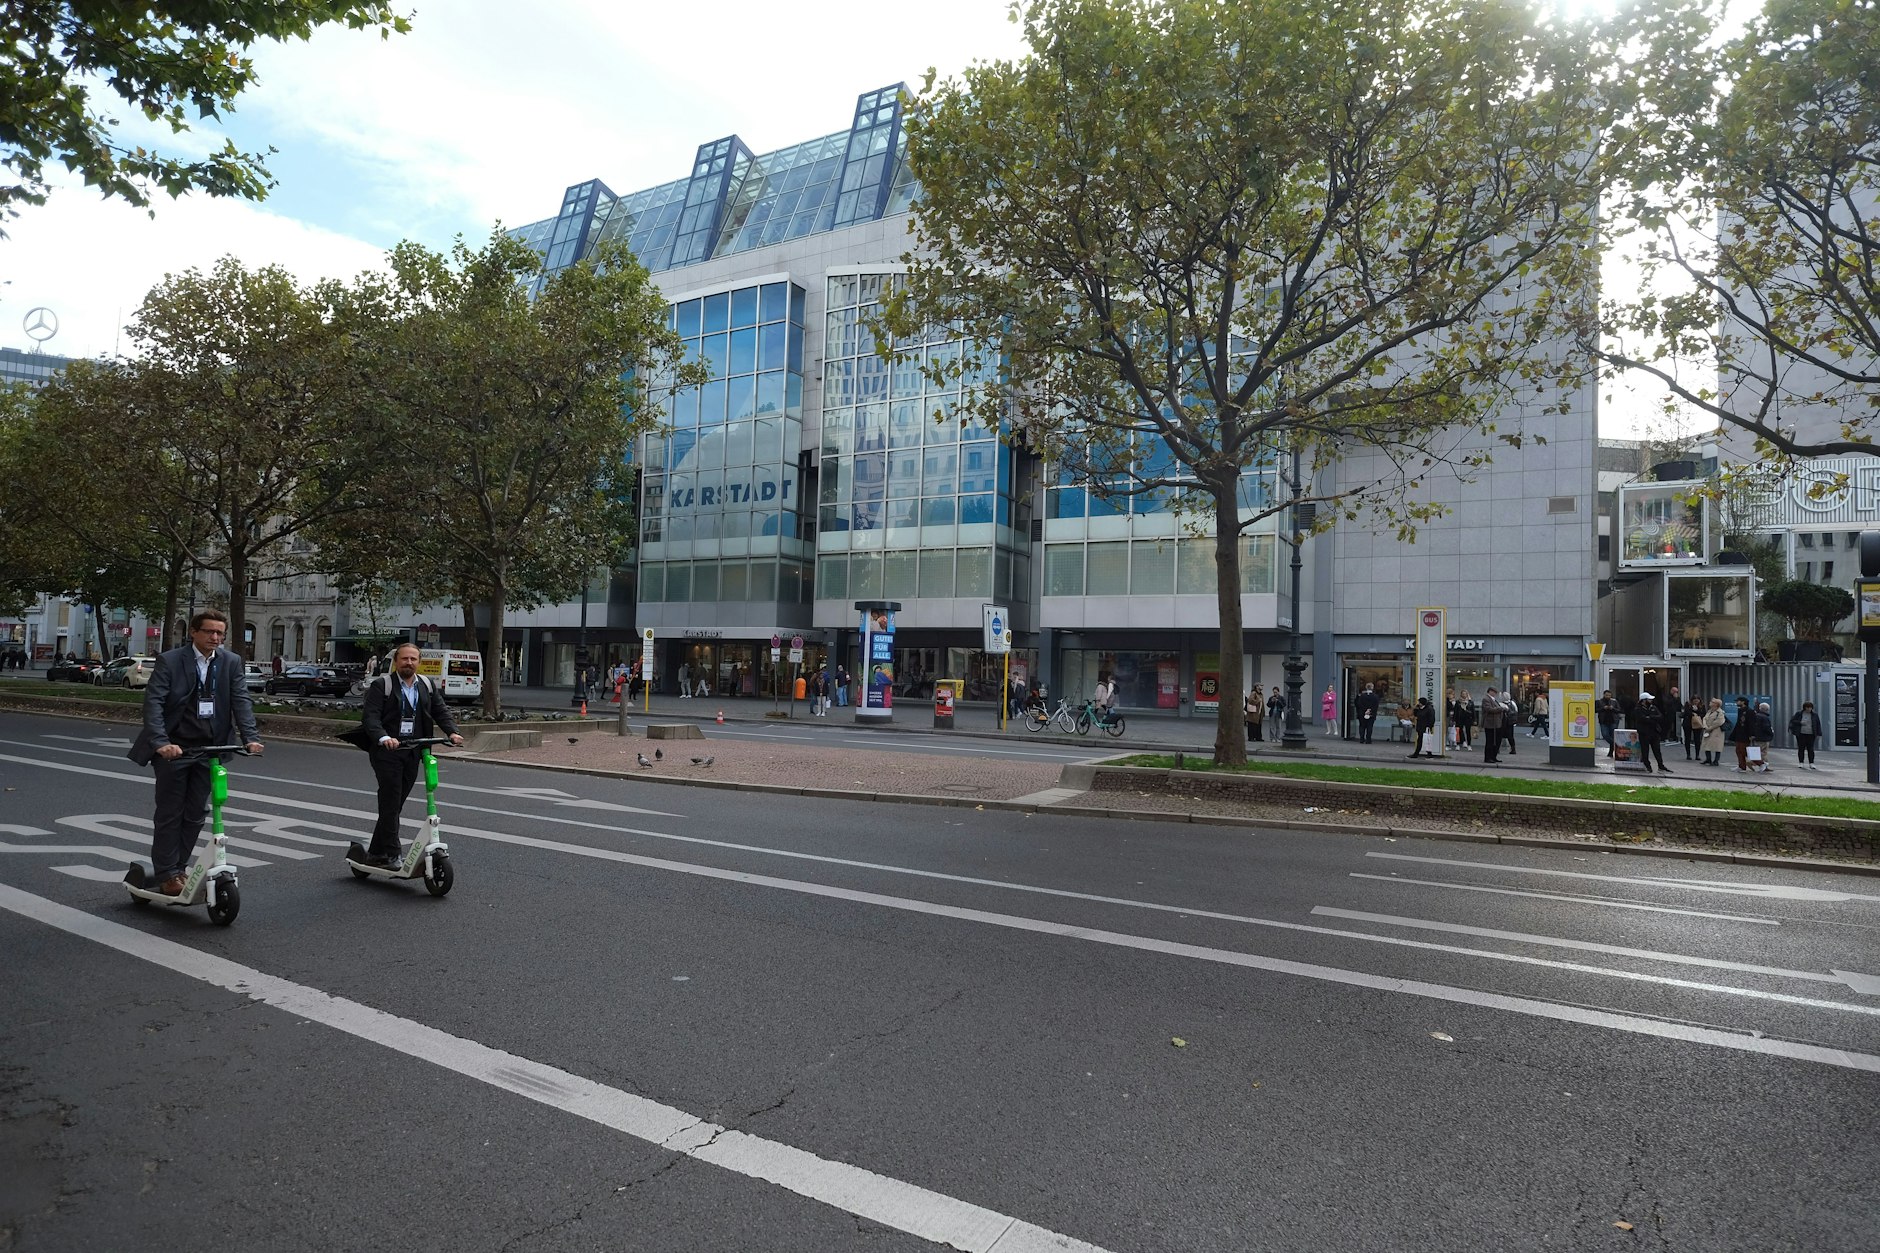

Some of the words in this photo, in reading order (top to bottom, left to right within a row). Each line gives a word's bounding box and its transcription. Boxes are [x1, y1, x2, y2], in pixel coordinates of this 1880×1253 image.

[671, 479, 792, 507] KARSTADT
[683, 630, 723, 638] KARSTADT
[874, 635, 893, 643] GUTES
[874, 643, 888, 651] FÜR
[1405, 639, 1485, 649] KTADT
[1201, 679, 1216, 694] 福
[406, 841, 422, 866] Lime
[185, 864, 204, 892] Lime
